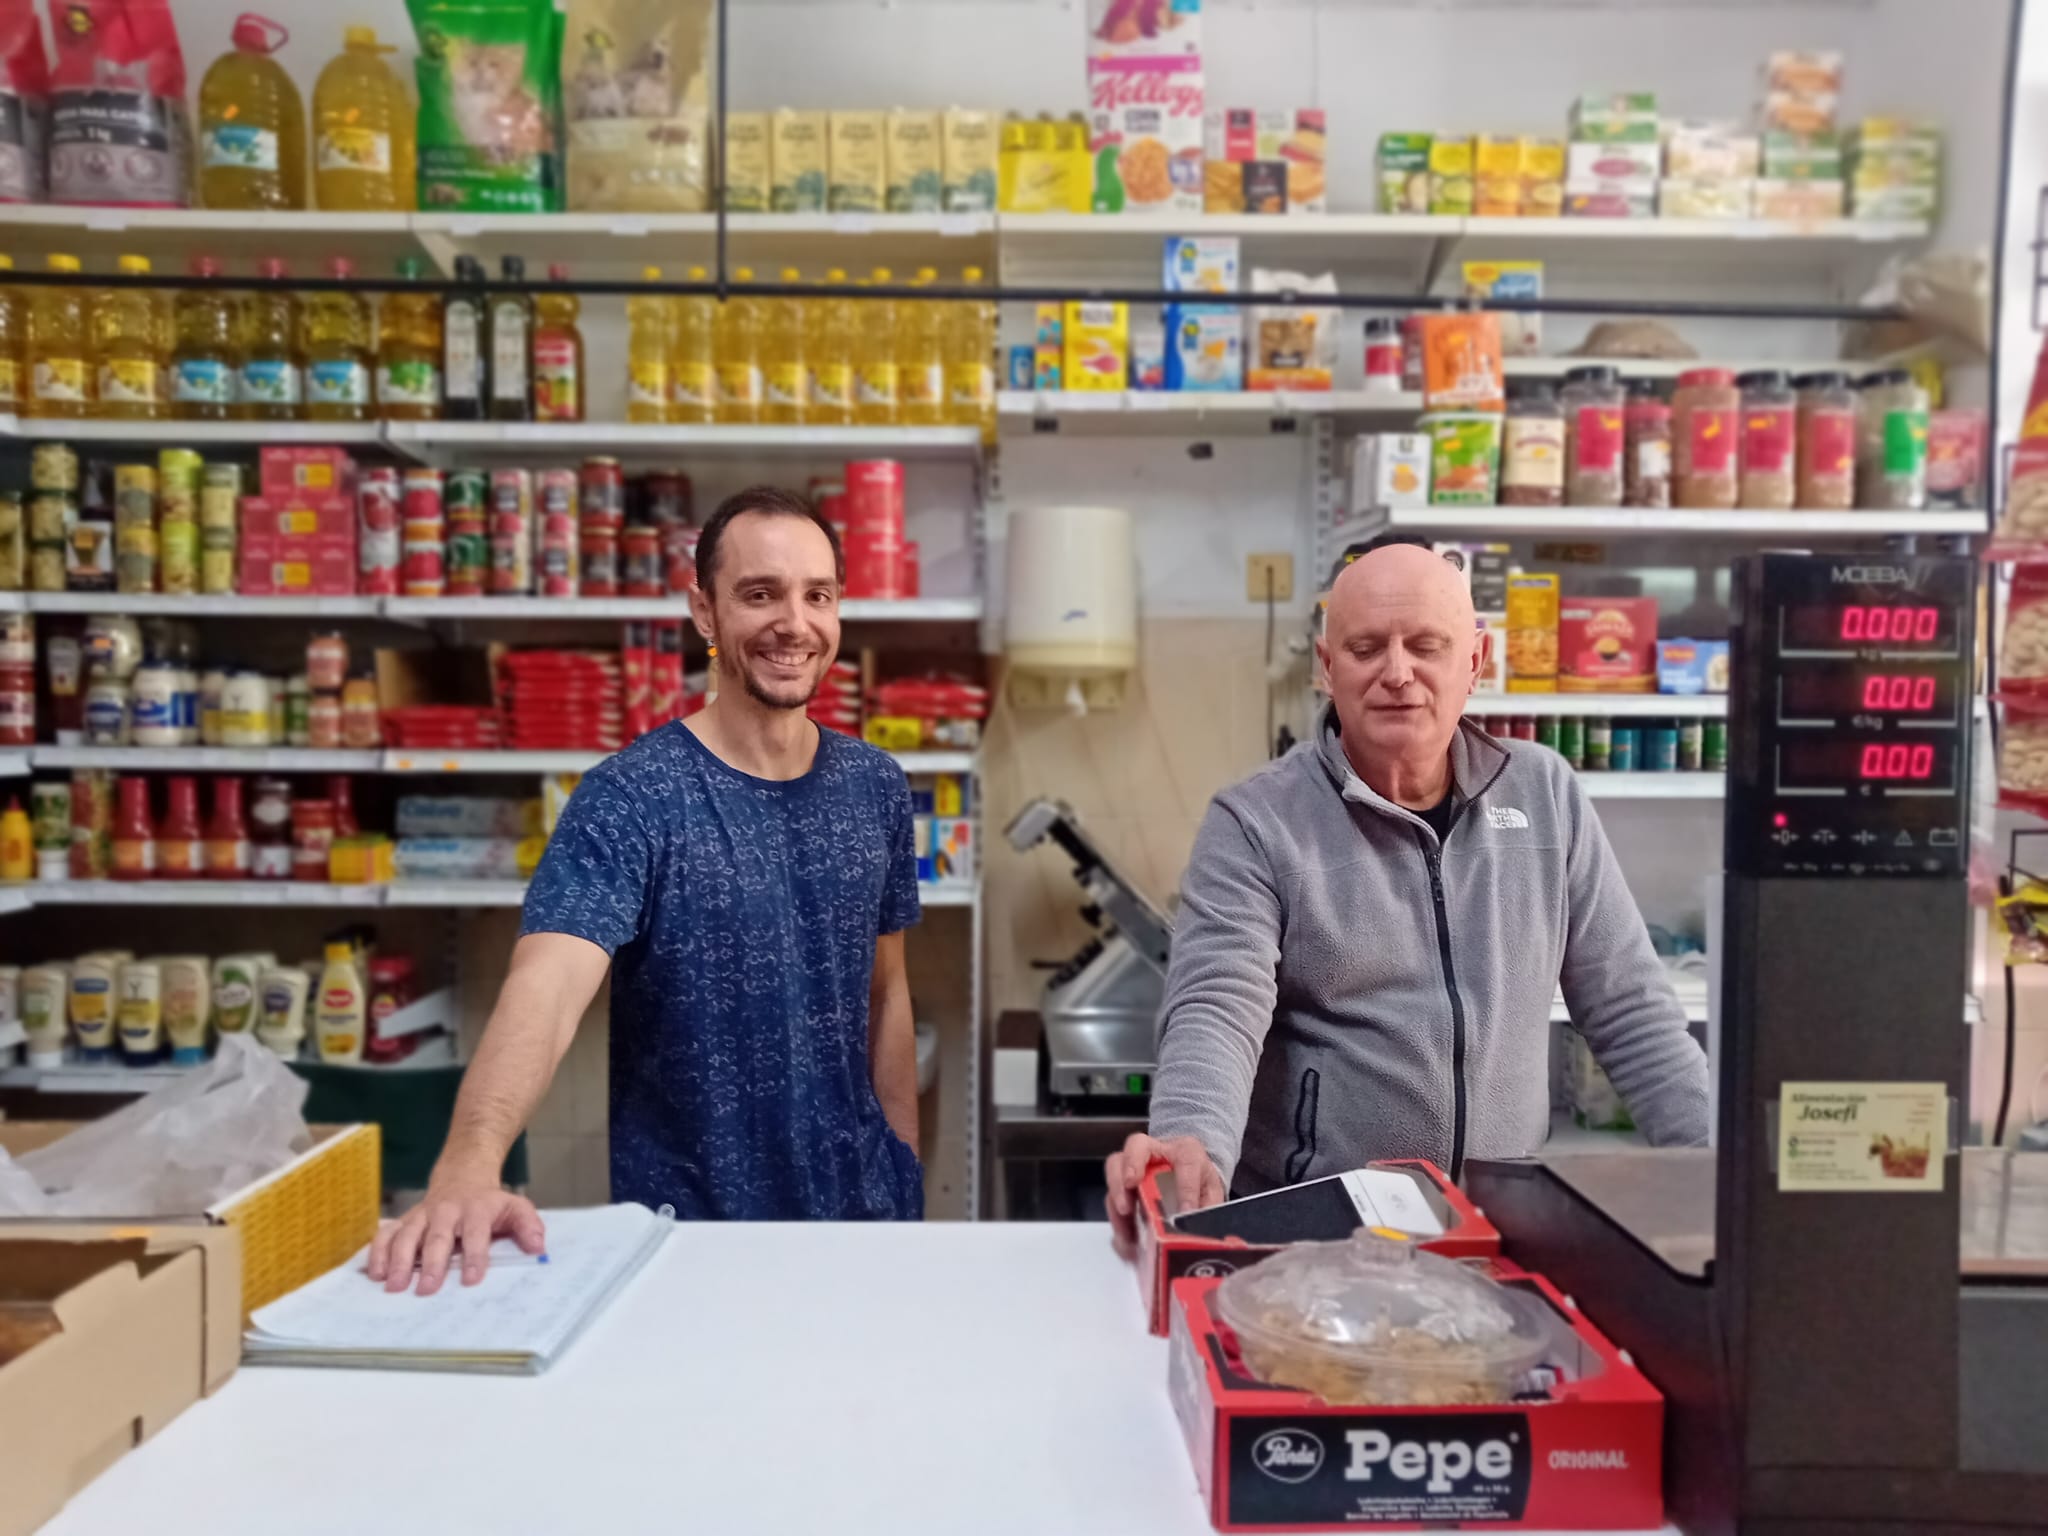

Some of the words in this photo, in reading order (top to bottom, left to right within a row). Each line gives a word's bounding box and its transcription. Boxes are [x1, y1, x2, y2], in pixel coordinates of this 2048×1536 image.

[1840, 606, 1939, 641] 0.000
[1862, 676, 1937, 710] 0.00
[1860, 744, 1935, 778] 0.00
[1797, 1104, 1858, 1123] Josefi
[1344, 1430, 1513, 1493] Pepe
[1548, 1450, 1629, 1470] ORIGINAL
